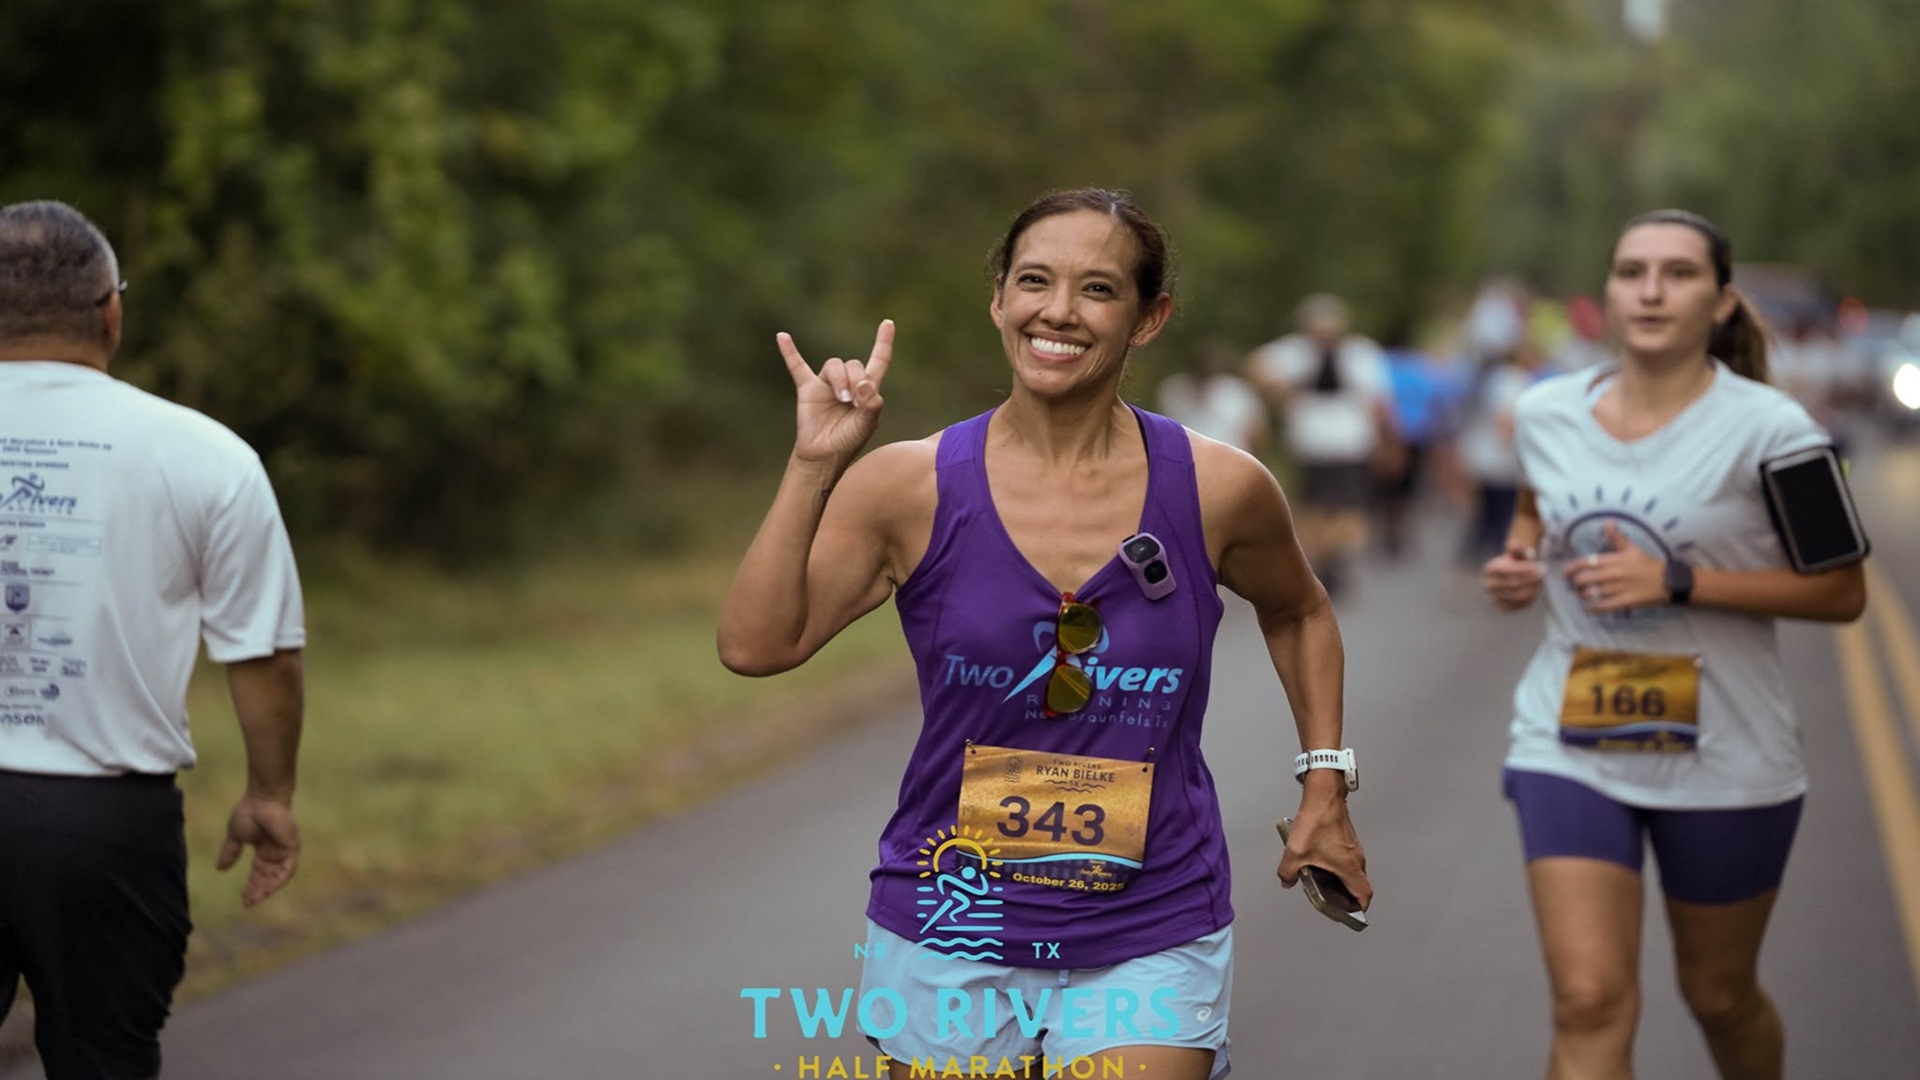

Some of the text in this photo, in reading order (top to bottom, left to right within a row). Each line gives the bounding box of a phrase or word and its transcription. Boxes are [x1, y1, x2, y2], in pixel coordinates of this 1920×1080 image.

[945, 654, 1014, 688] Two
[1026, 694, 1171, 711] RNING
[1591, 682, 1666, 717] 166
[1036, 765, 1115, 783] RYAN BIELKE
[997, 795, 1106, 847] 343
[1012, 872, 1125, 891] October 26, 2025
